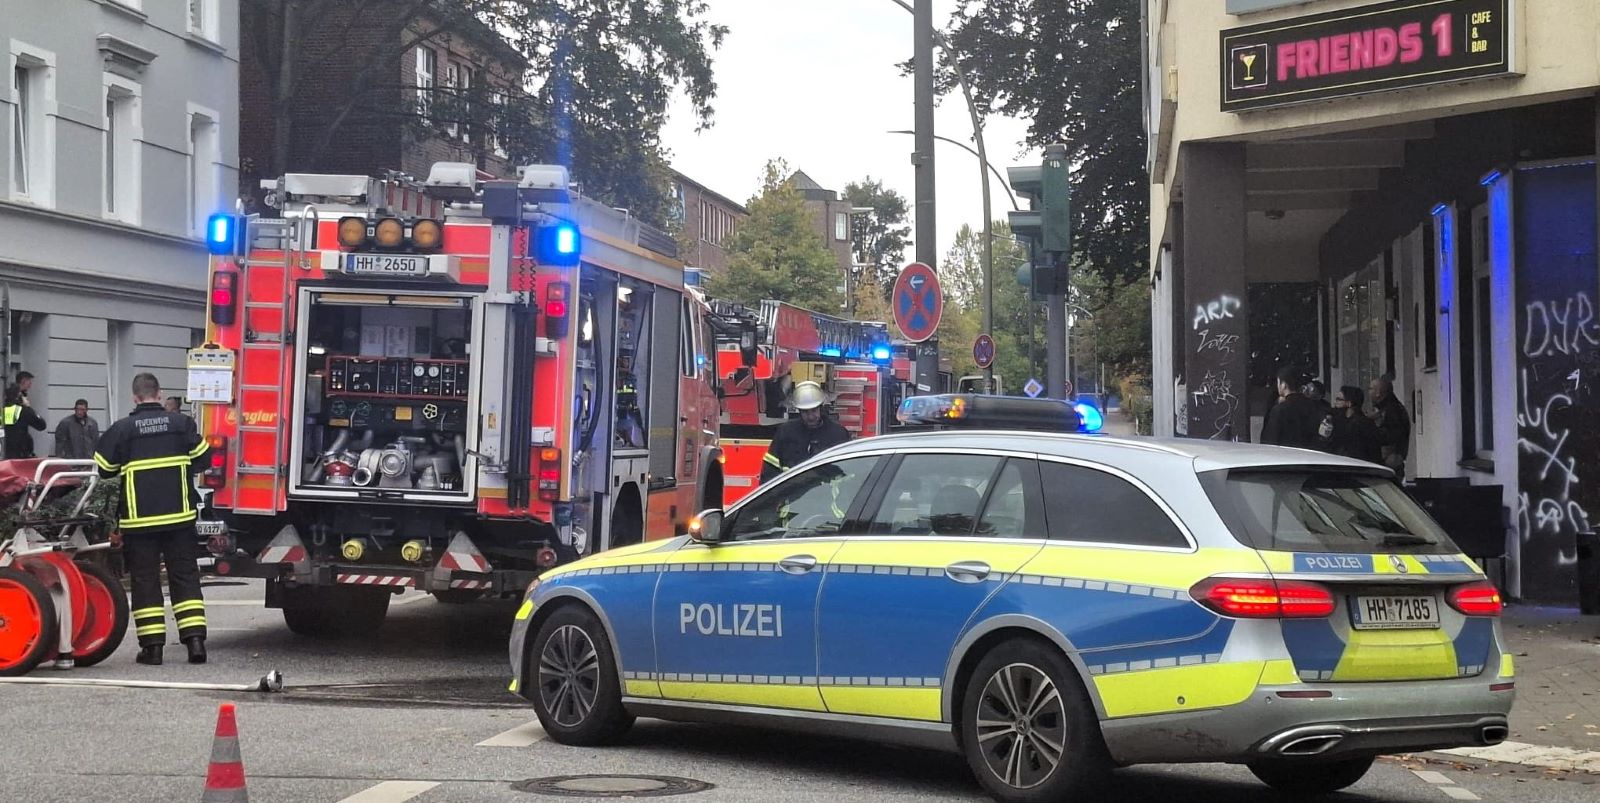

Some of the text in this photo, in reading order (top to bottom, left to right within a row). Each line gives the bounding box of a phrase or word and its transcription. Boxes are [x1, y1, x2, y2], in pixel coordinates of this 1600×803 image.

[1471, 11, 1491, 24] CAFE
[1471, 26, 1480, 39] &
[1276, 13, 1453, 81] FRIENDS 1
[1471, 40, 1488, 53] BAR
[356, 257, 416, 272] HH 2650
[1305, 557, 1363, 569] POLIZEI
[1366, 598, 1431, 621] HH 7185
[680, 603, 783, 637] POLIZEI
